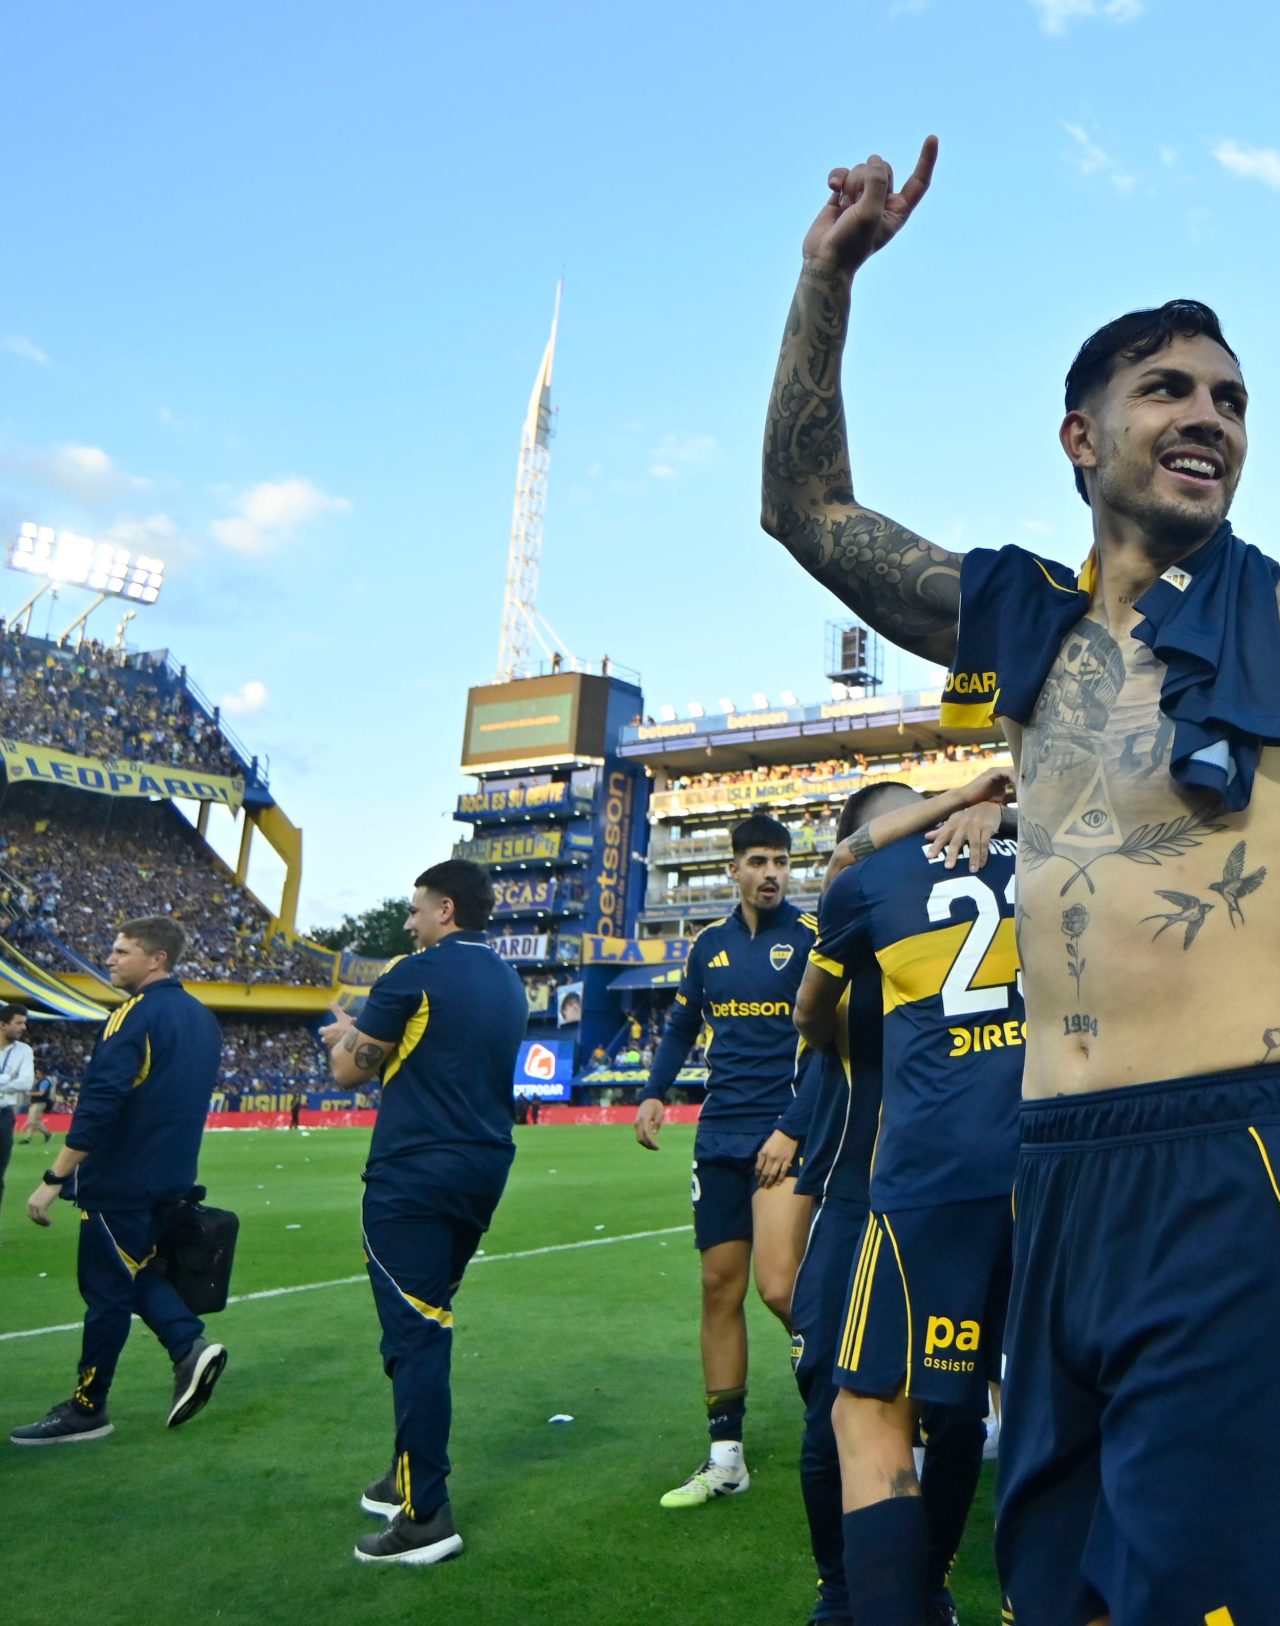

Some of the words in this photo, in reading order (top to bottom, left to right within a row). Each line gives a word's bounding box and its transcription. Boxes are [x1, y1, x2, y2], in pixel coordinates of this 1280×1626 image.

[25, 757, 229, 801] LEOPARDI
[591, 937, 645, 962] LA
[710, 998, 791, 1018] betsson
